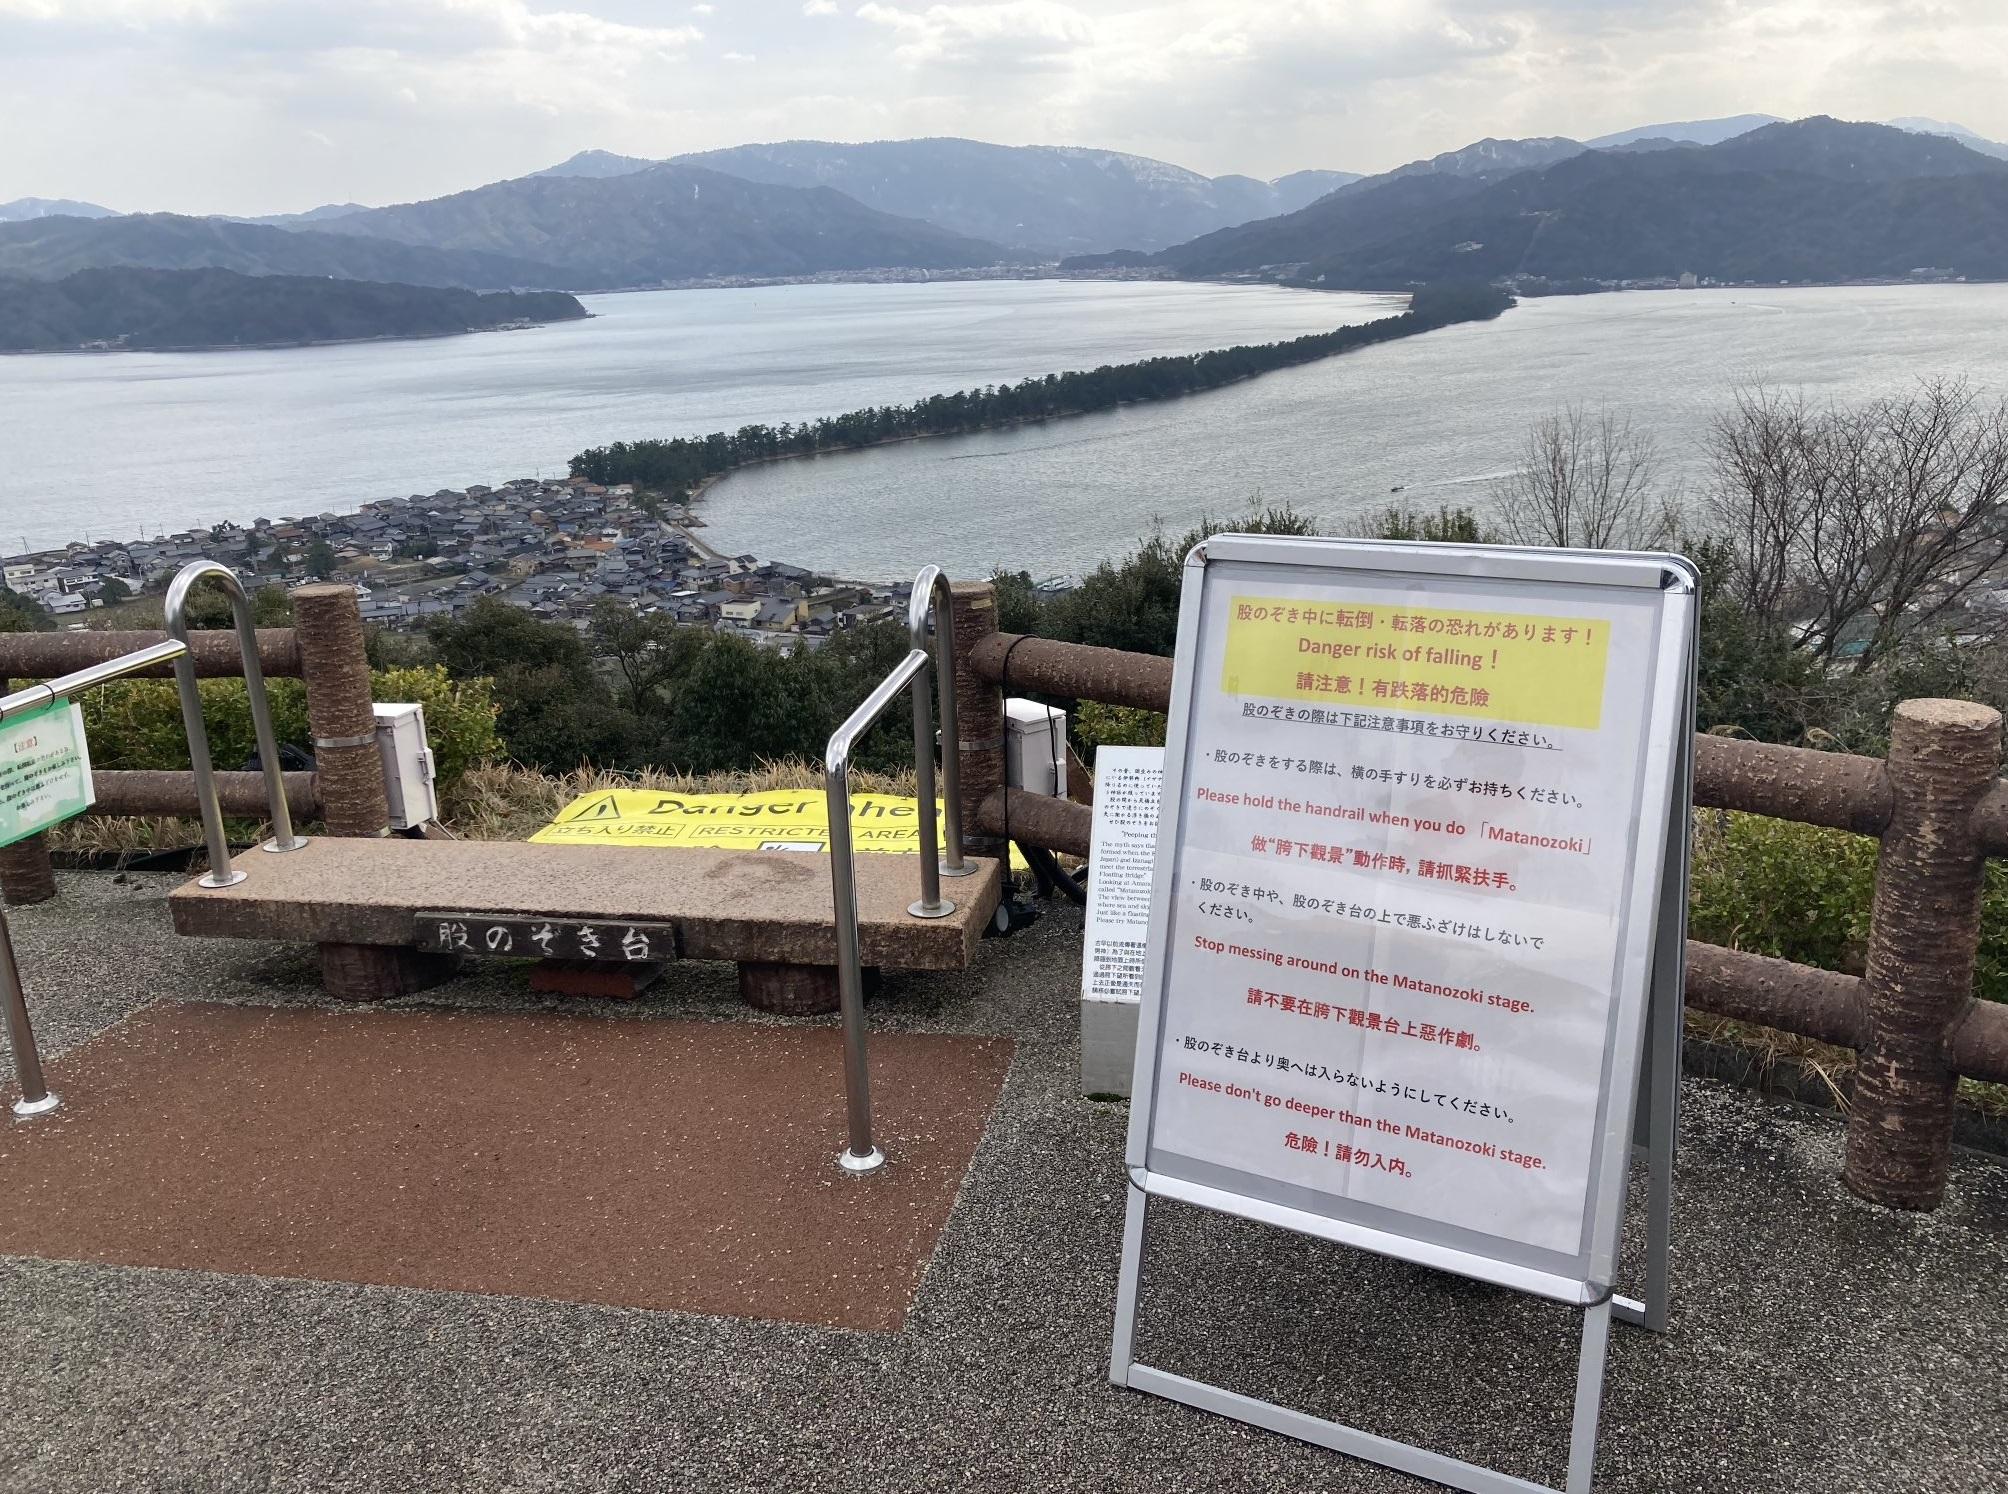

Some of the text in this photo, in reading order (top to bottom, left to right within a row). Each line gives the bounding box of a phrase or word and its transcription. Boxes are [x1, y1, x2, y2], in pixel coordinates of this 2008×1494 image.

[1298, 637, 1361, 659] Danger
[1366, 643, 1397, 660] risk
[1402, 646, 1422, 662] of
[1242, 702, 1553, 749] 股のぞきの際は下記注意事項をお守りください。
[1196, 787, 1240, 804] Please
[1243, 793, 1273, 809] hold
[1278, 798, 1301, 812] the
[1305, 801, 1365, 821] handrail
[1368, 811, 1409, 828] when
[1414, 817, 1441, 833] you
[1445, 820, 1466, 835] do
[555, 823, 676, 837] 立ち入り禁止
[698, 826, 920, 839] RESTRICTE AREA
[1198, 901, 1253, 924] ください。
[1194, 935, 1535, 1014] Stop messing around on the Matanozoki stage.
[1179, 1072, 1547, 1170] Please don't go deeper than the Matanozoki stage.
